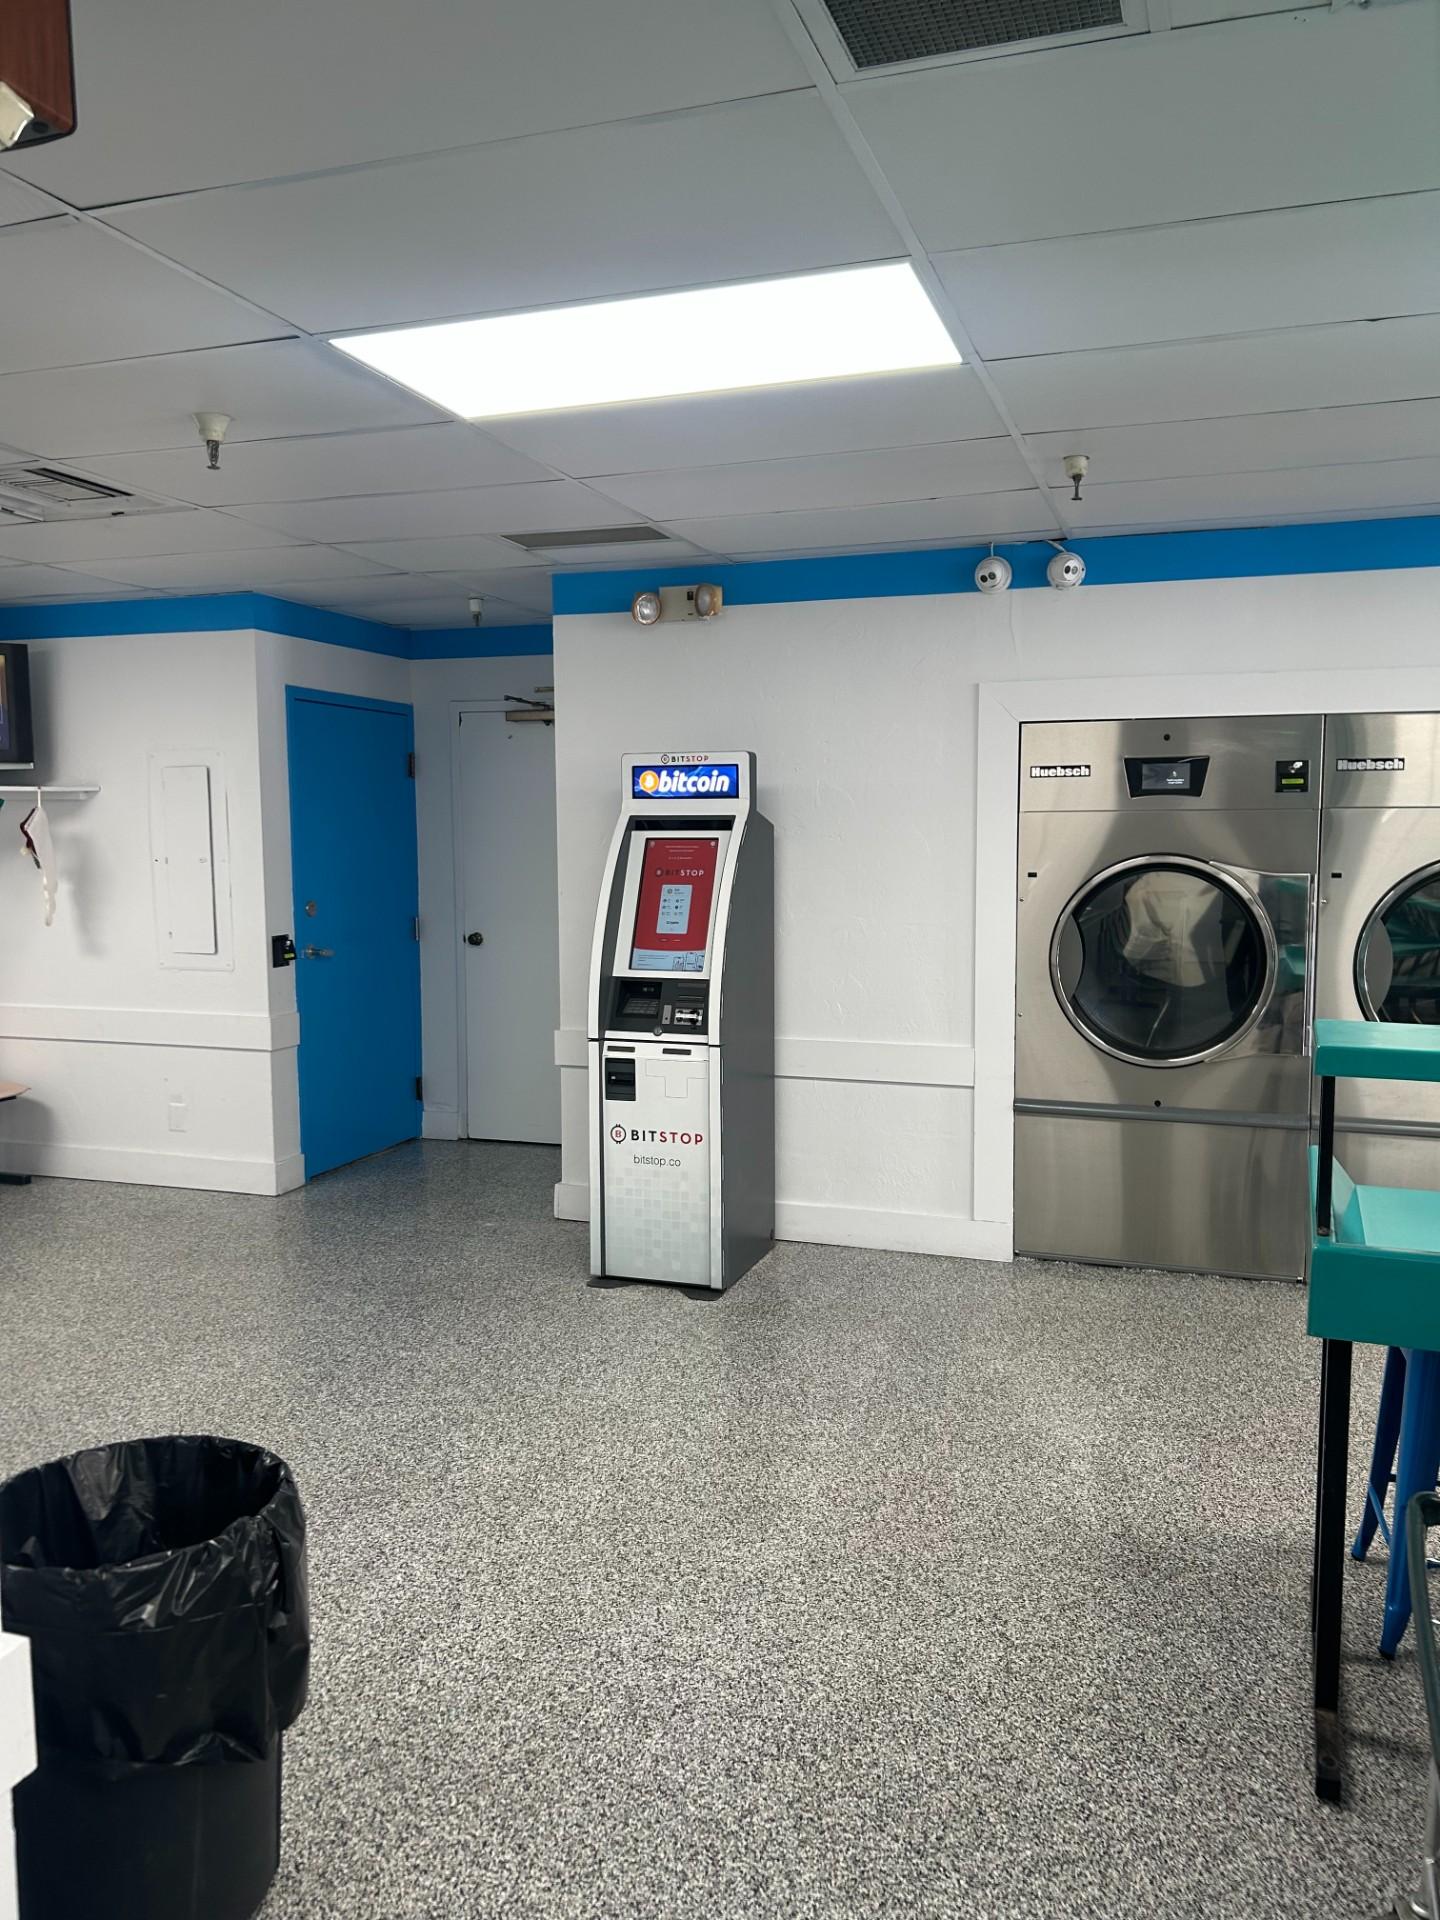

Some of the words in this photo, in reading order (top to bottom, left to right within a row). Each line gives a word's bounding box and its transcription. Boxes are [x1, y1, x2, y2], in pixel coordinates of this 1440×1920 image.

[671, 755, 708, 763] BITSTOP
[1337, 759, 1404, 770] Huebsch
[1031, 766, 1090, 777] Huebsch
[658, 769, 730, 793] bitcoin
[631, 1129, 704, 1145] BITSTOP
[633, 1155, 681, 1168] bitstop.co
